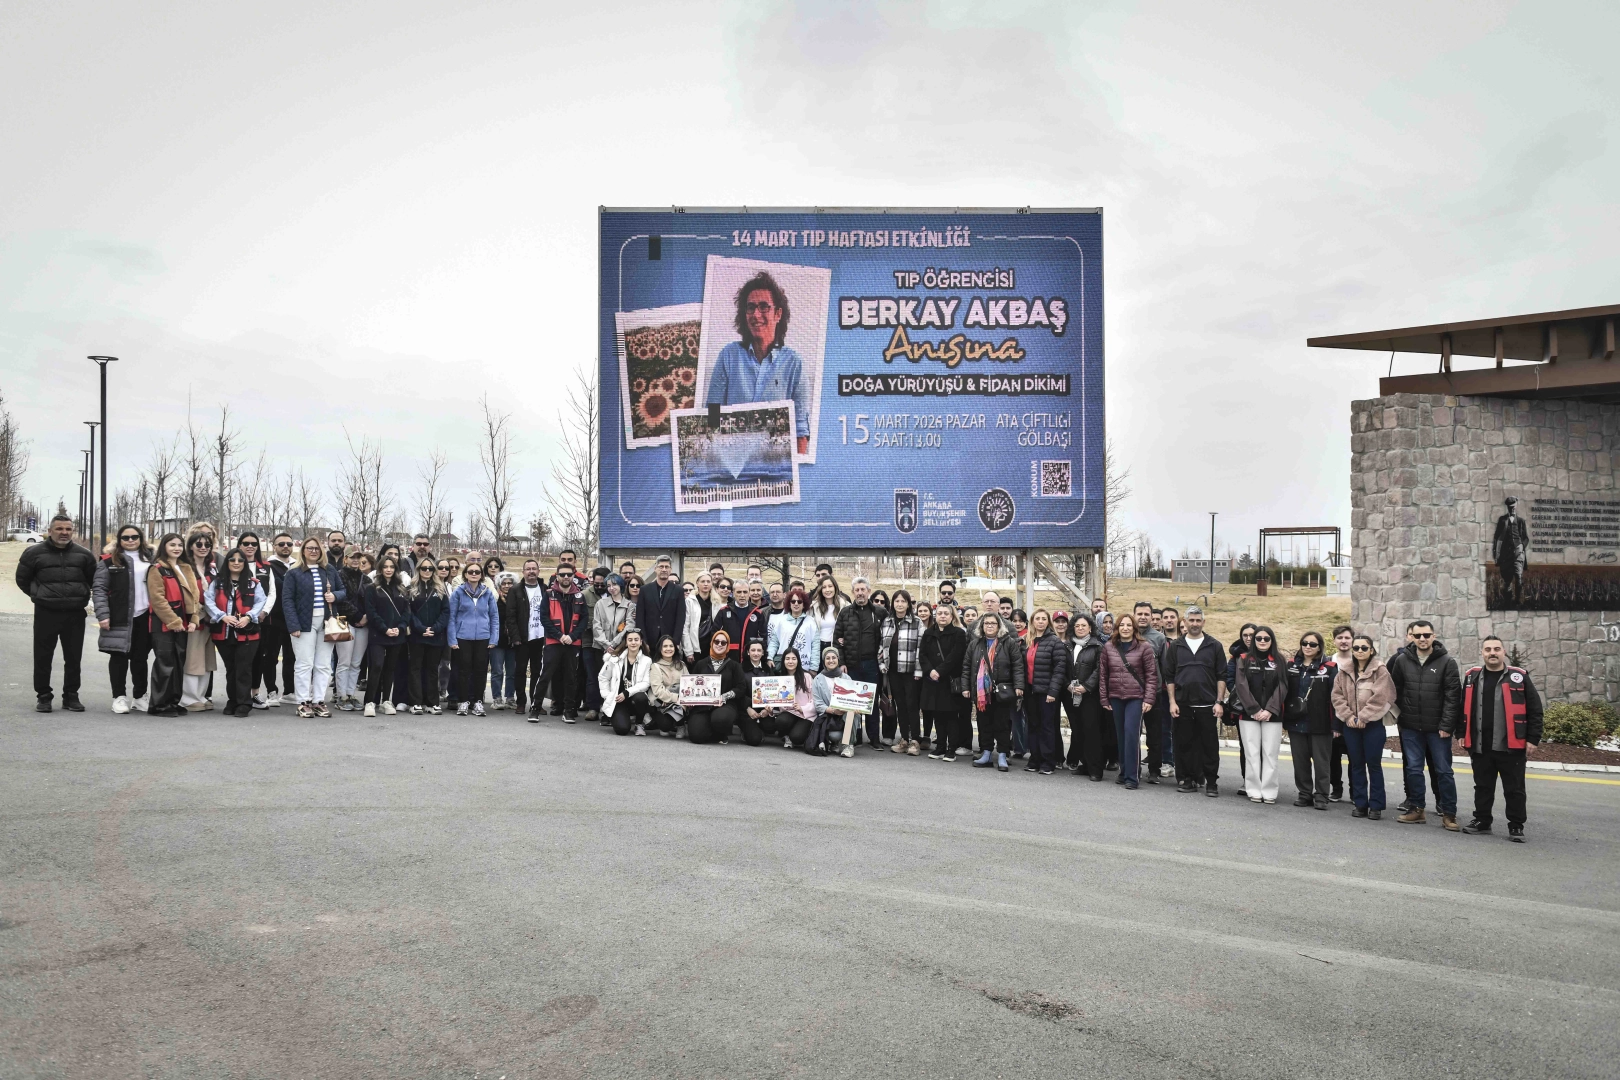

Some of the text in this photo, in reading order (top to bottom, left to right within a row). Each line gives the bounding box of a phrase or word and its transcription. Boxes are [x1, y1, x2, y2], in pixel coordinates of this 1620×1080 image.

[732, 225, 971, 247] 14 MART TIP HAFTASI ETKİNLİĞİ
[894, 268, 1014, 288] TIP ÖĞRENCİSİ
[840, 299, 1067, 333] BERKAY AKBAŞ
[842, 374, 1067, 394] DOĞA YÜRÜYÜŞÜ & FİDAN DİKİMİ
[838, 413, 870, 445] 15
[874, 413, 910, 429] MART
[913, 414, 943, 429] 2026
[946, 413, 986, 429] PAZAR
[996, 413, 1019, 428] ATA
[1018, 429, 1071, 451] GÖLBAŞI
